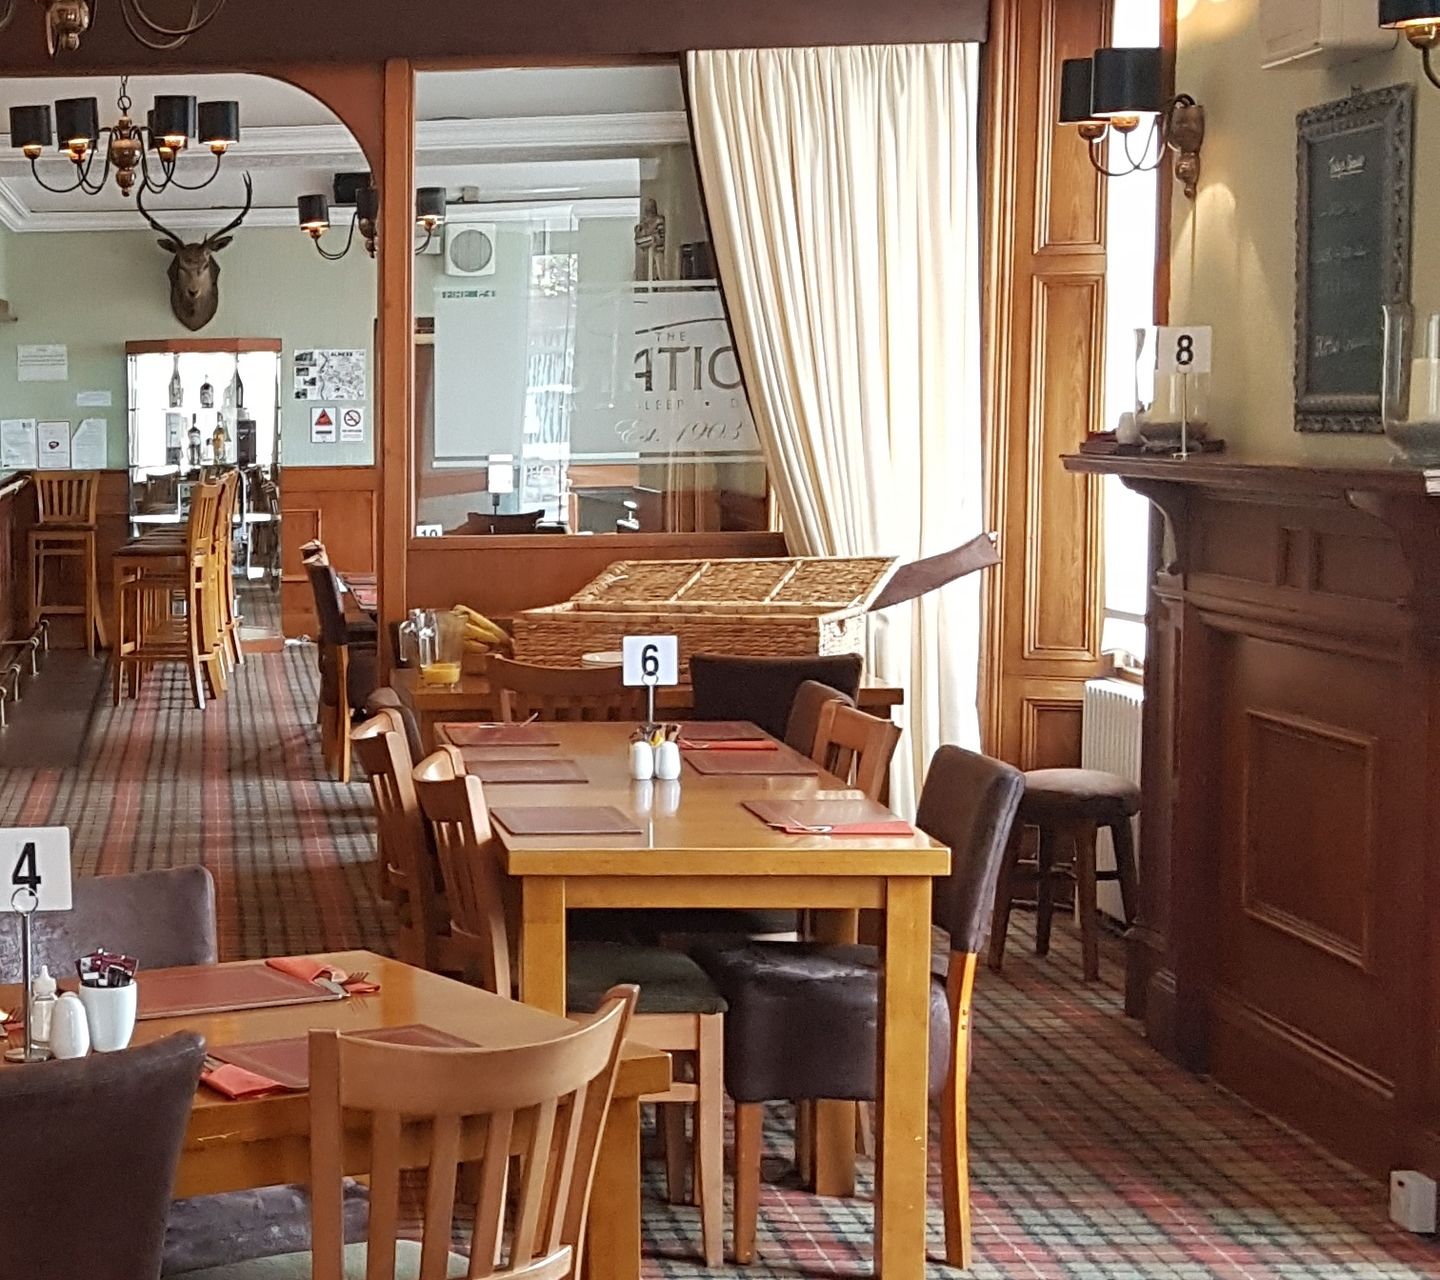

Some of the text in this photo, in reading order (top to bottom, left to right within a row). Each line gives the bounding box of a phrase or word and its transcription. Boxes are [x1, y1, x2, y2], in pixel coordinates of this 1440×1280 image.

[655, 332, 686, 342] THE
[1176, 334, 1193, 366] 8
[641, 644, 659, 676] 6
[12, 842, 42, 896] 4
